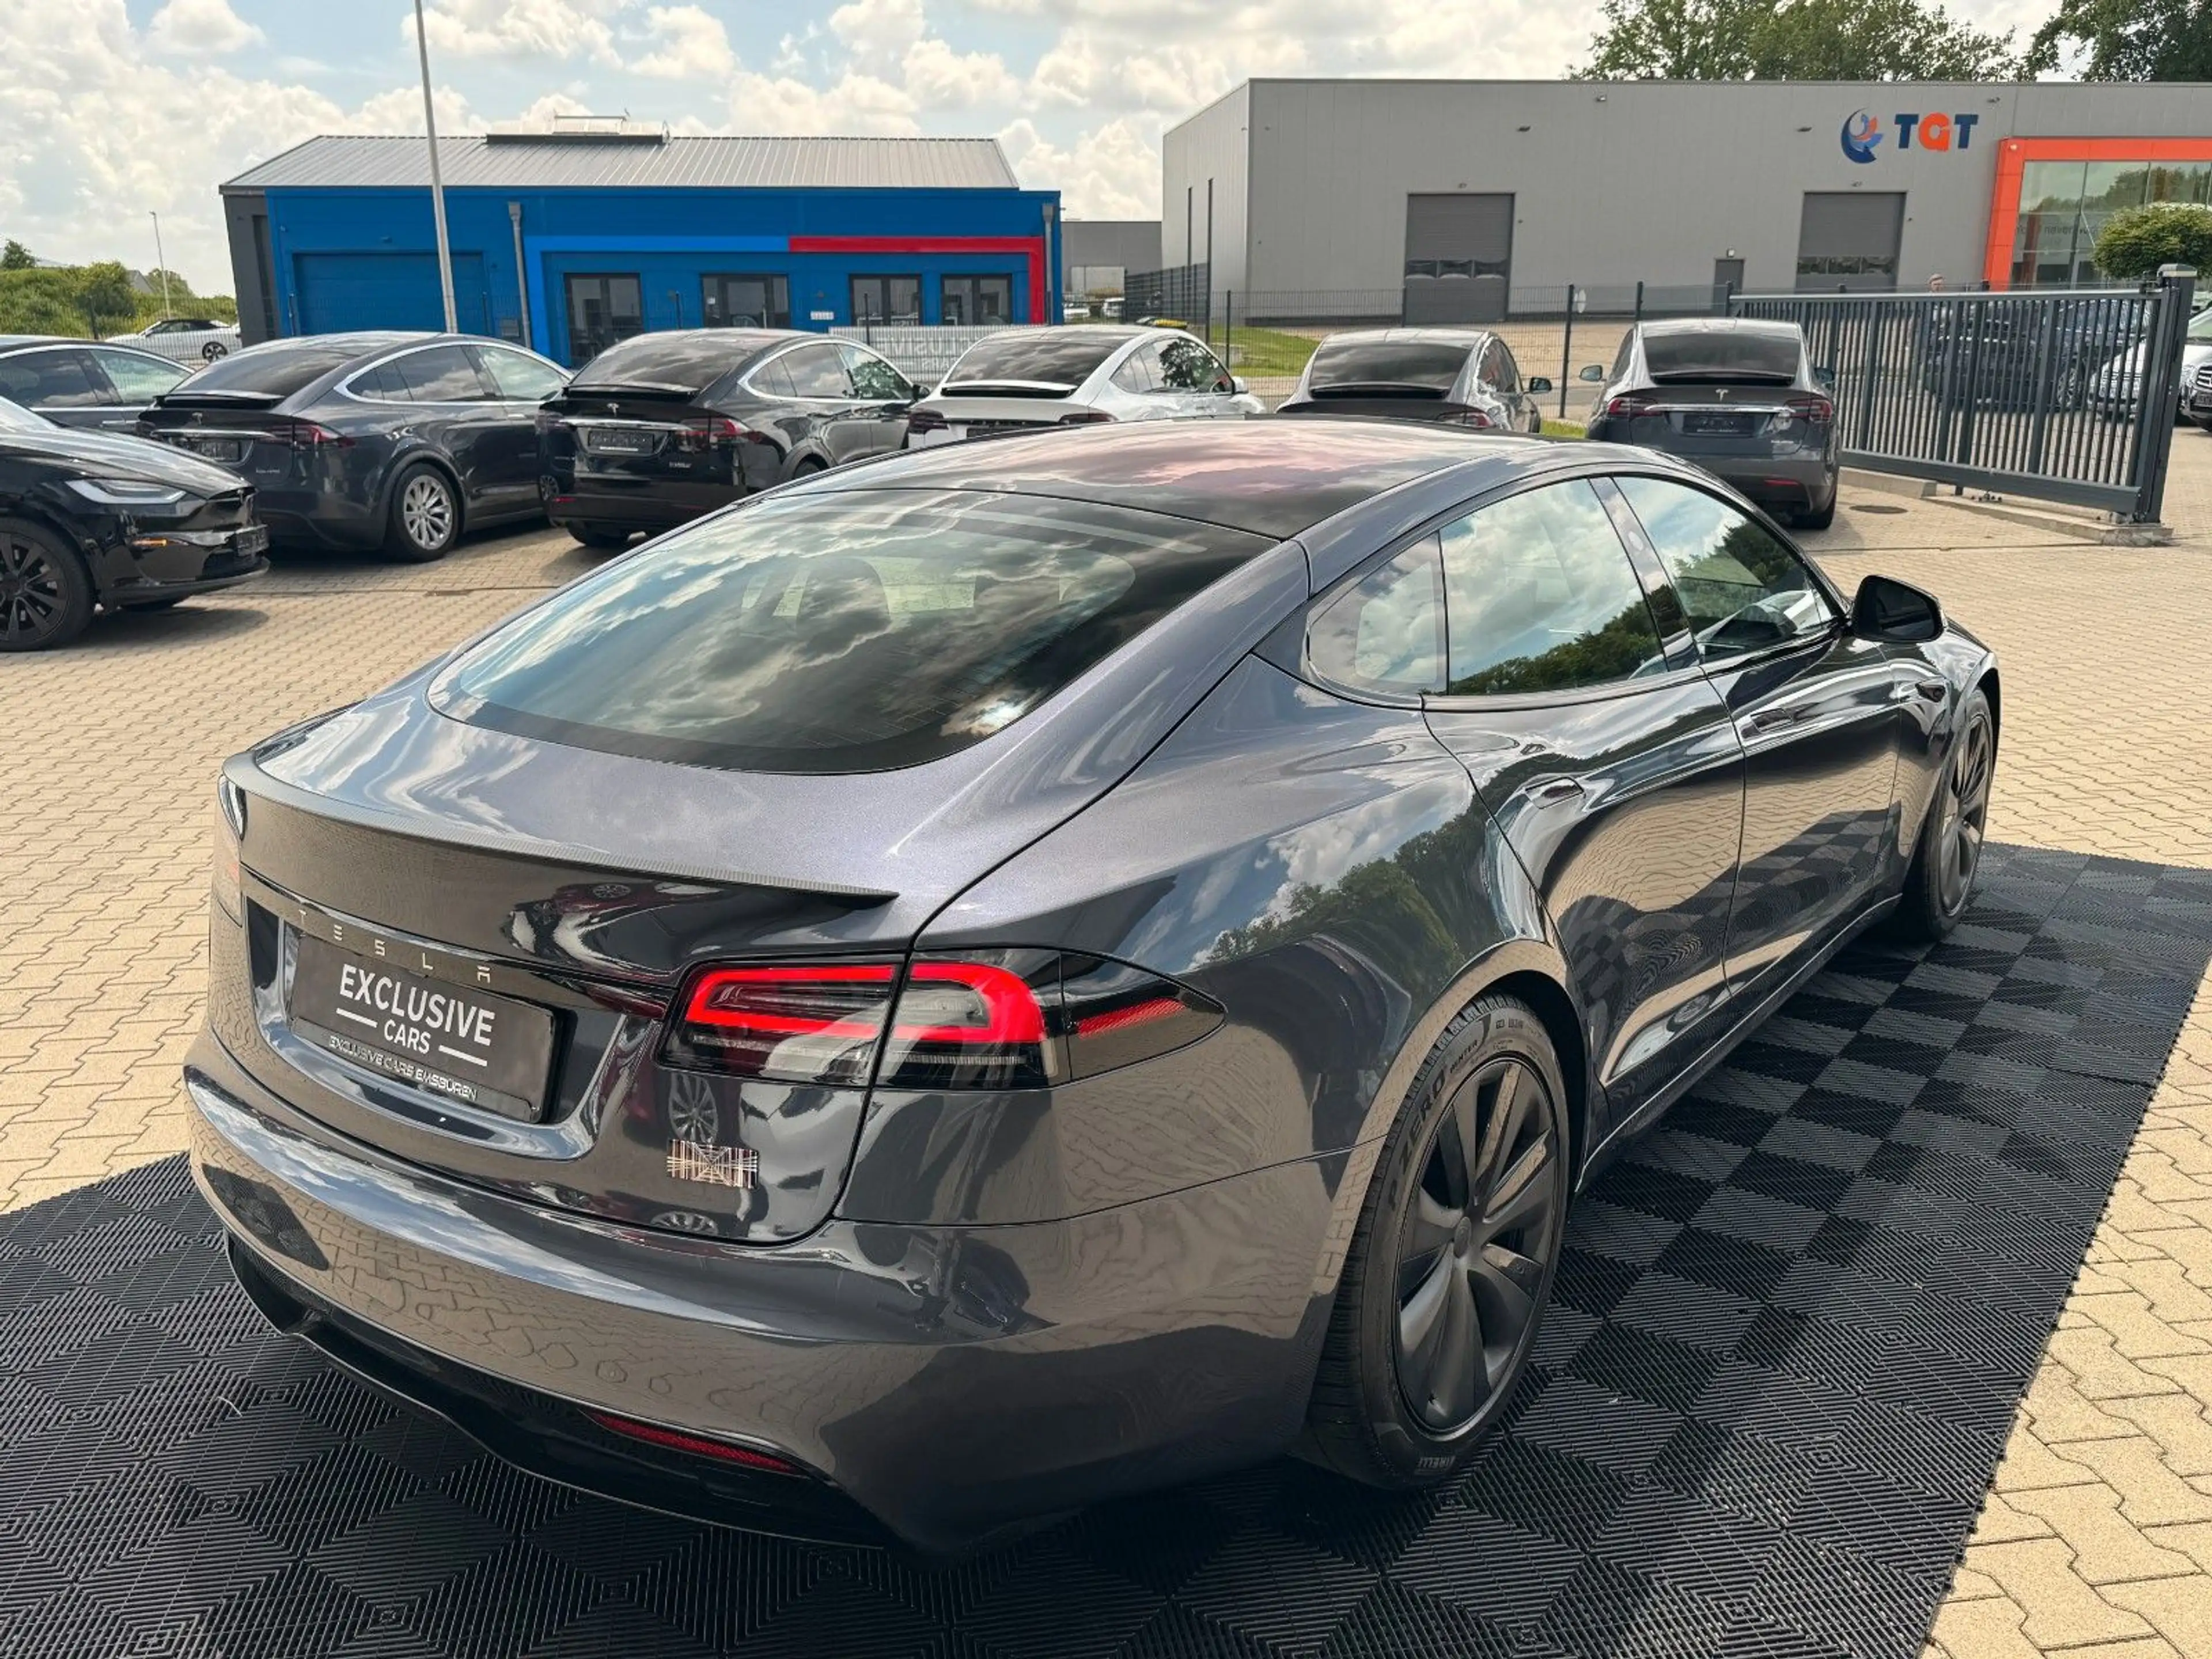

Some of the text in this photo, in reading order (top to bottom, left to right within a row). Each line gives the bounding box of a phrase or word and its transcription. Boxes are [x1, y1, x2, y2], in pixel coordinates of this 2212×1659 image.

[1894, 111, 1979, 152] TGT
[298, 910, 491, 983] TESLA
[340, 963, 496, 1046] EXCLUSIVE
[384, 1018, 431, 1055] CARS
